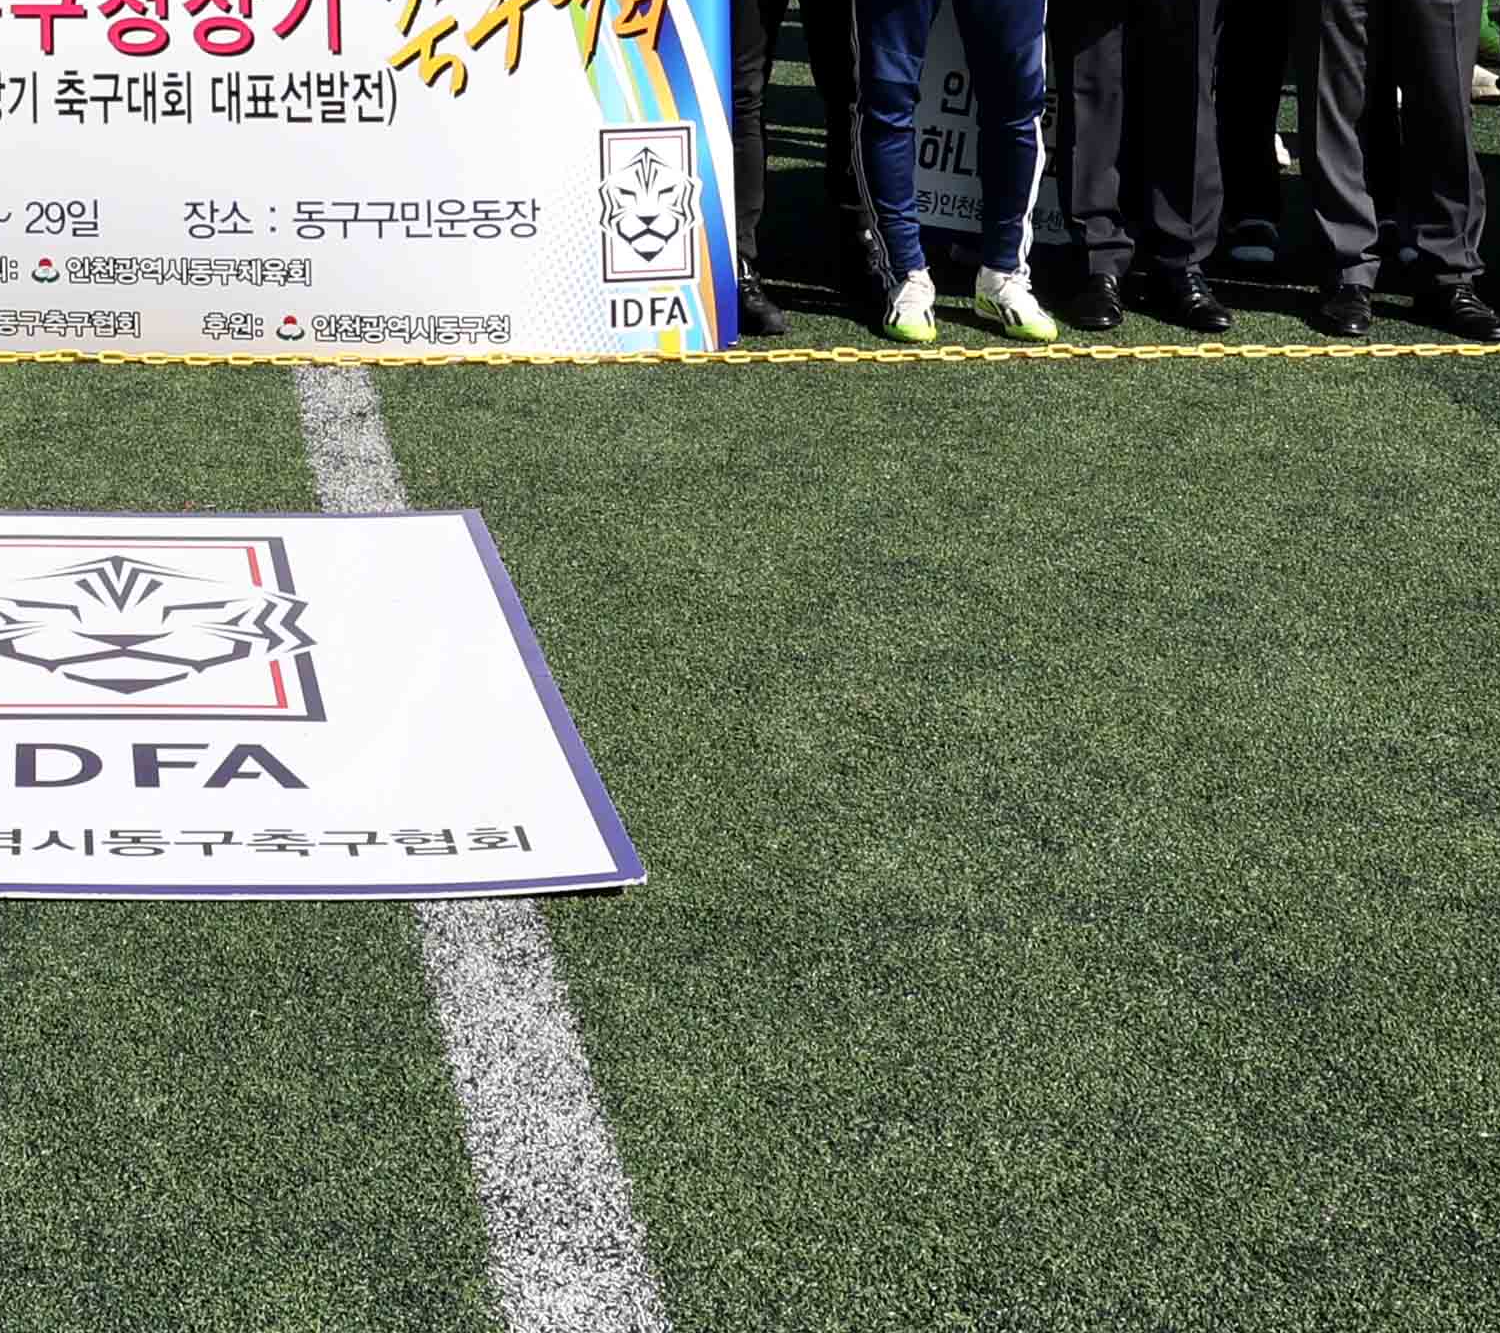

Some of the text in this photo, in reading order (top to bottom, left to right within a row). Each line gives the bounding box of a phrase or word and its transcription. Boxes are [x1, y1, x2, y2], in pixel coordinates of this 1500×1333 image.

[54, 70, 193, 124] 축구대회
[211, 69, 398, 125] 대표선발전)
[25, 199, 101, 238] 29일
[184, 199, 254, 240] 장소
[293, 198, 541, 239] 동구구민운동장
[66, 256, 312, 286] 인천광역시동구체육회
[202, 312, 511, 344] 후원: 인천광역시동구청
[610, 295, 688, 328] IDFA
